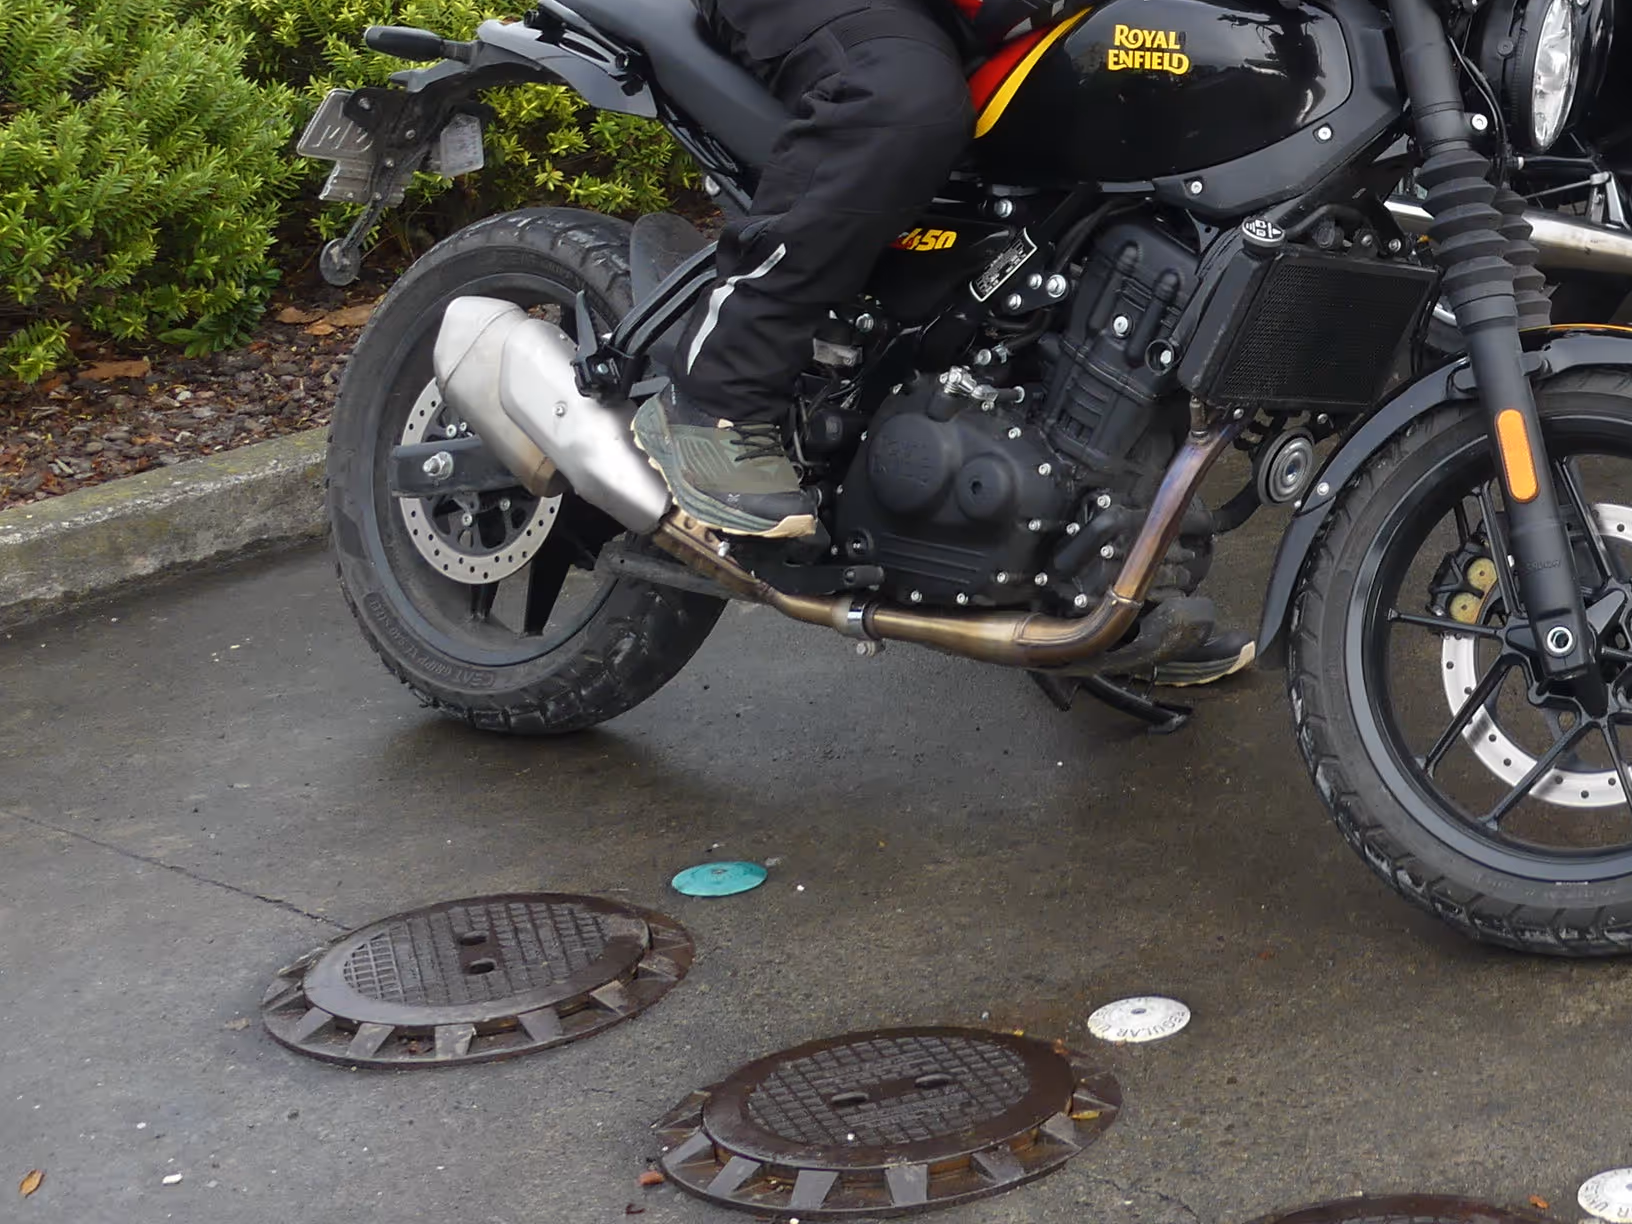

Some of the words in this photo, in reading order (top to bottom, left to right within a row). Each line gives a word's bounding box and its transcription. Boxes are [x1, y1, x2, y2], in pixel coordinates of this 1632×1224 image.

[1114, 24, 1181, 50] ROYAL
[1107, 49, 1190, 75] ENFIELD
[902, 228, 957, 251] 450
